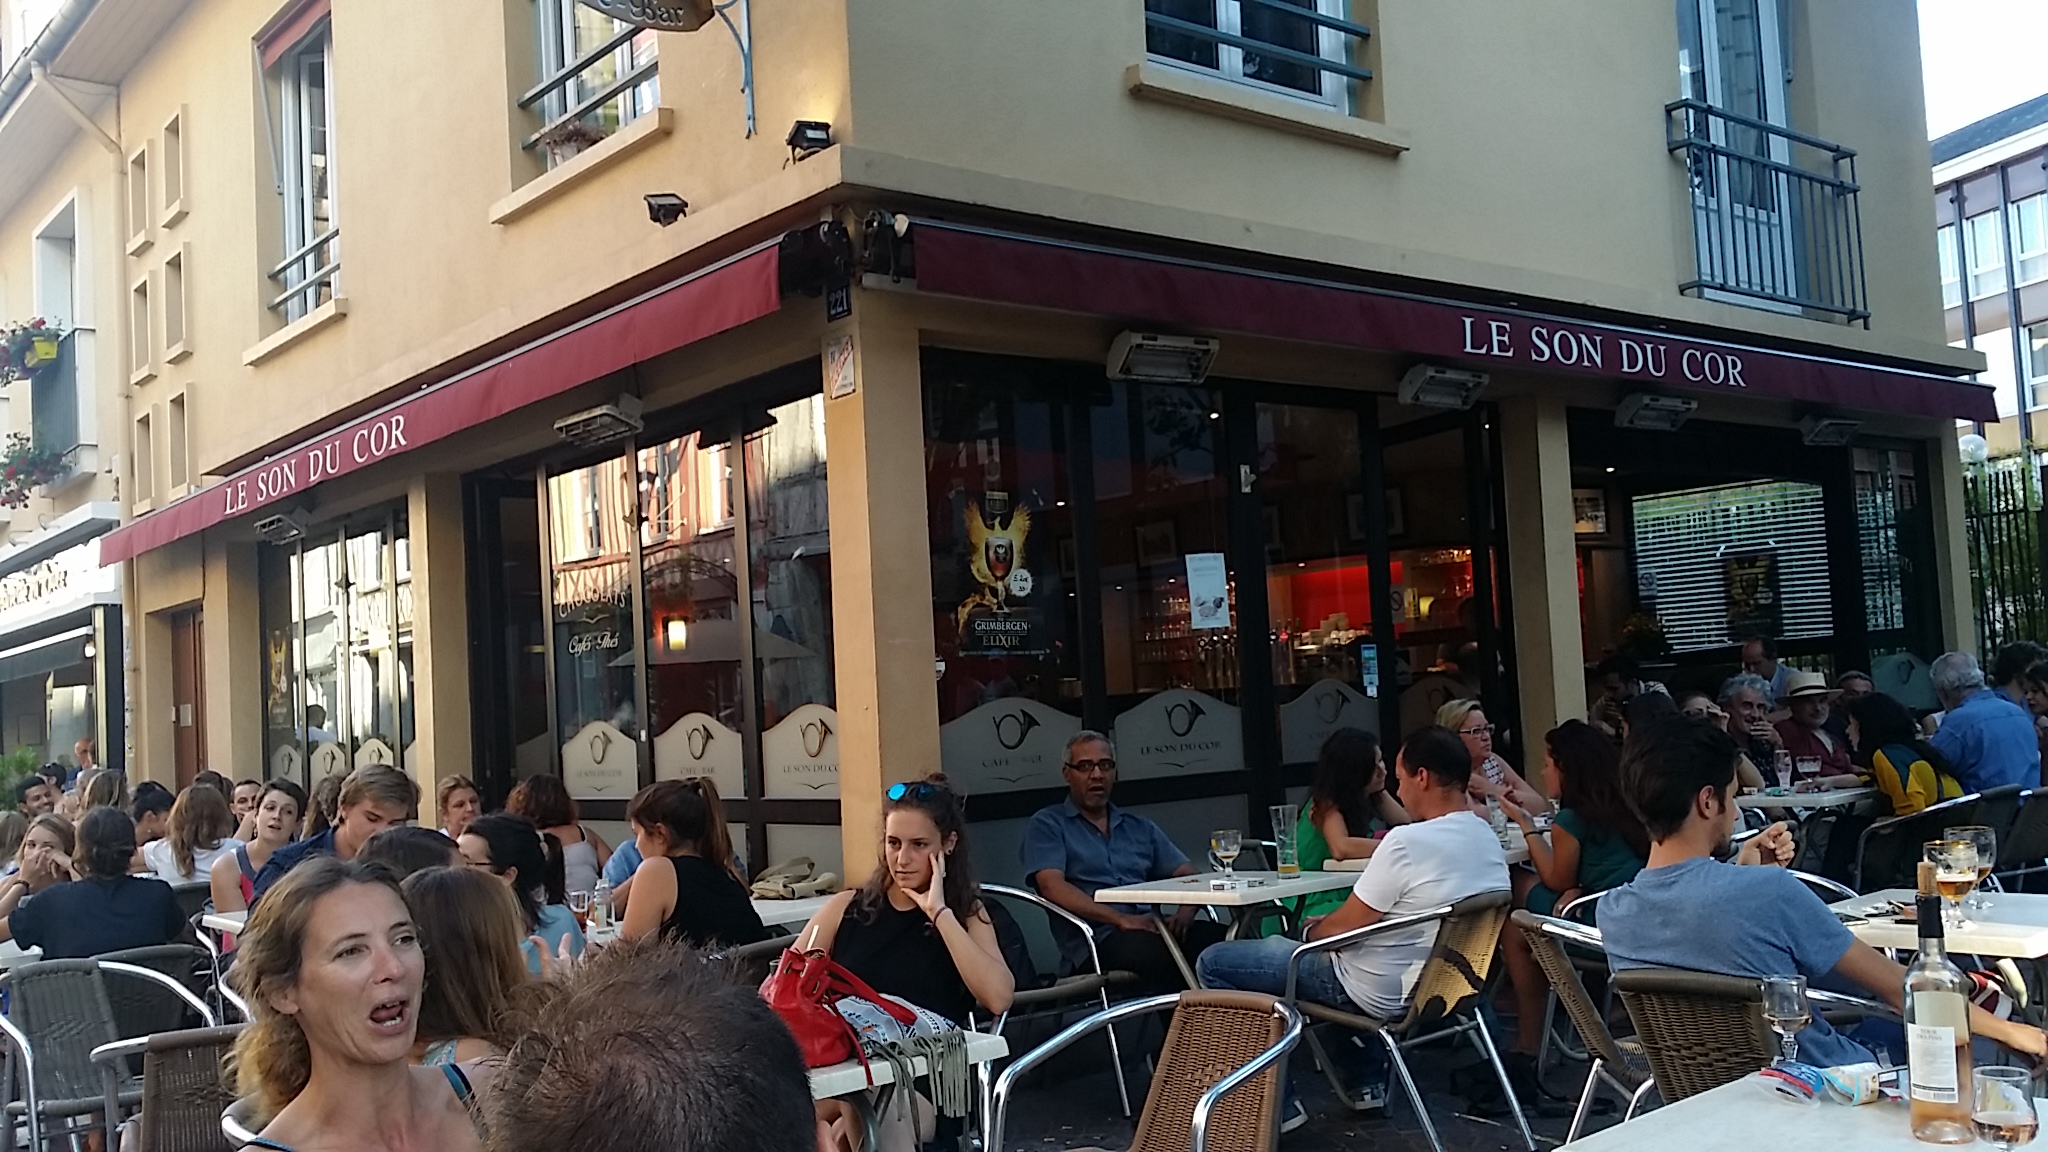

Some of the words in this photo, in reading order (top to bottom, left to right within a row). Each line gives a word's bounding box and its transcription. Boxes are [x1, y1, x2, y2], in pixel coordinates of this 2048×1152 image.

[828, 287, 848, 314] 221
[1461, 316, 1515, 357] LE
[1530, 326, 1603, 369] SON
[1619, 339, 1666, 377] DU
[1682, 349, 1746, 388] COR
[224, 480, 248, 515] LE
[256, 459, 297, 502] SON
[308, 440, 341, 482] DU
[352, 414, 407, 463] COR
[559, 586, 626, 618] CHOCOLATS
[974, 620, 1028, 631] GRIMBERGEN
[1154, 744, 1177, 754] SON
[1180, 743, 1196, 752] DU
[1198, 741, 1222, 751] COR
[793, 764, 811, 773] SON
[813, 764, 827, 773] DU
[828, 763, 839, 773] CO
